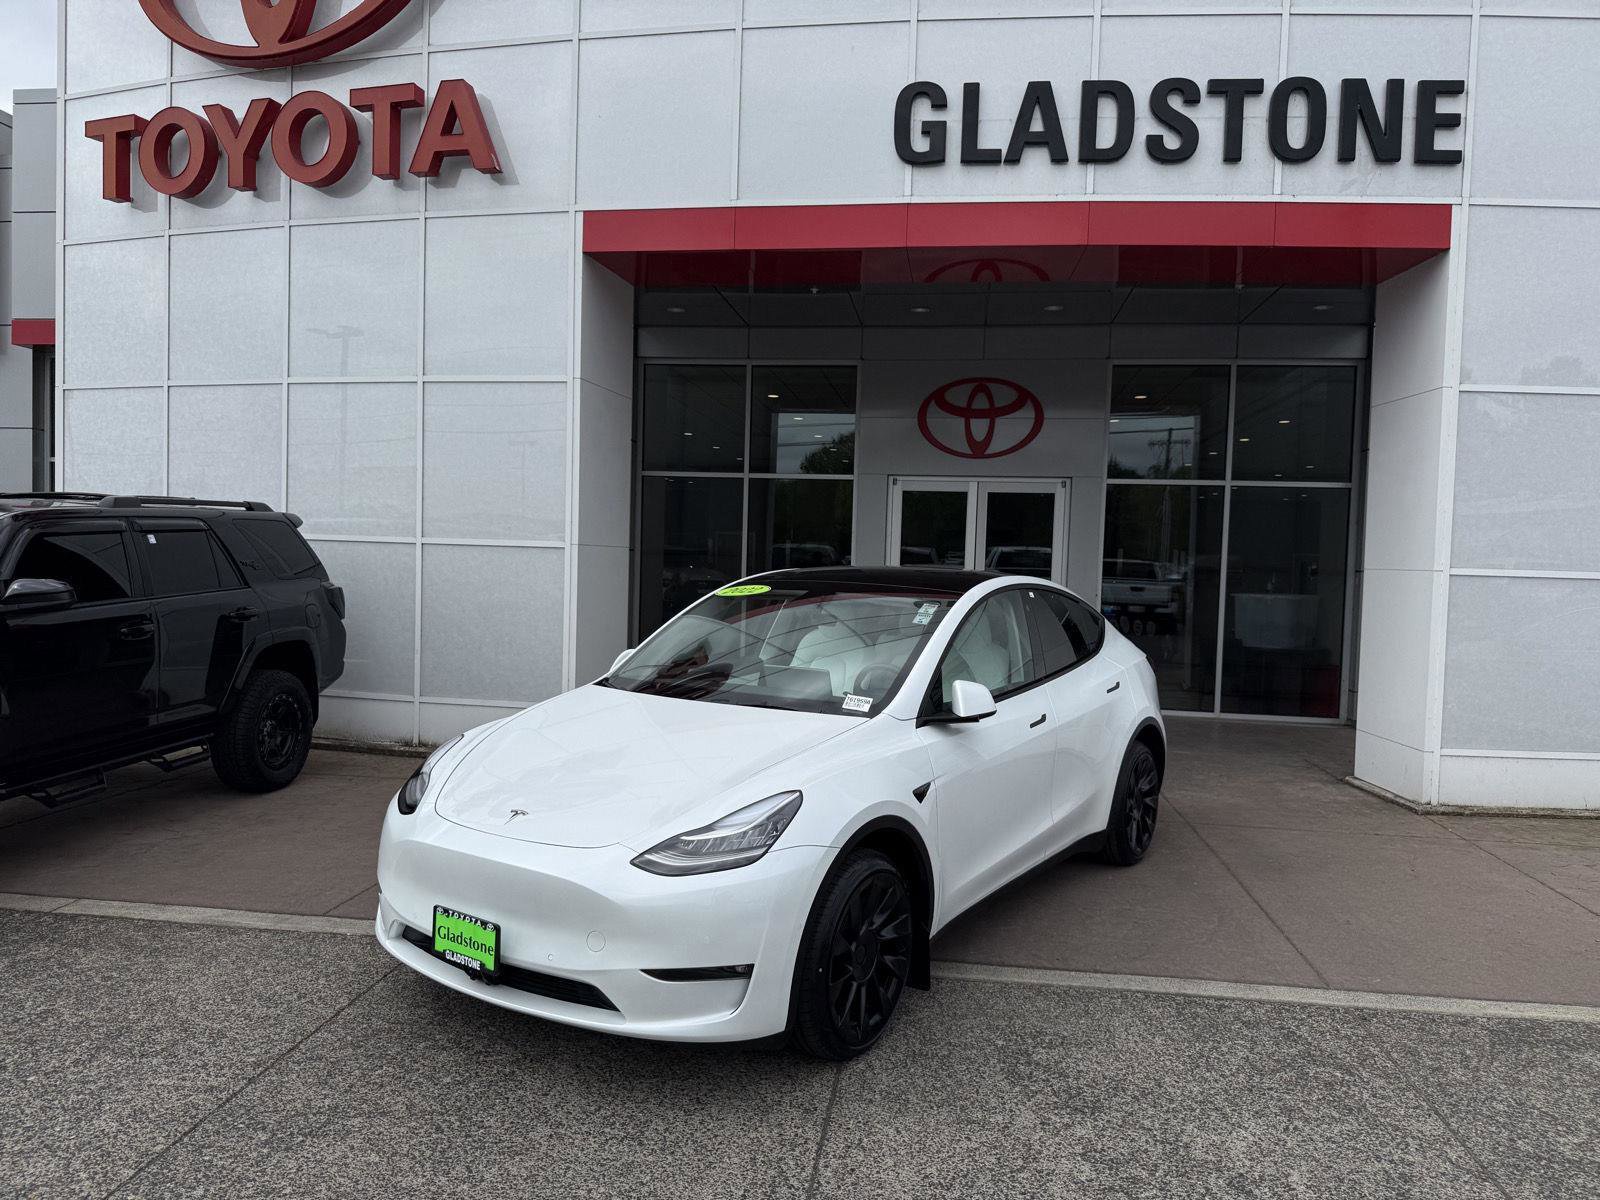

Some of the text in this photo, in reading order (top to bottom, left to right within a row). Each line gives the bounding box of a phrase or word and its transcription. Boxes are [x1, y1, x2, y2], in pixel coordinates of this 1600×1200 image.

[894, 77, 1465, 165] GLADSTONE
[85, 79, 503, 203] TOYOTA
[448, 910, 482, 927] TOYOTA
[437, 925, 494, 956] Gladstone
[445, 950, 481, 970] GLADSTONE
